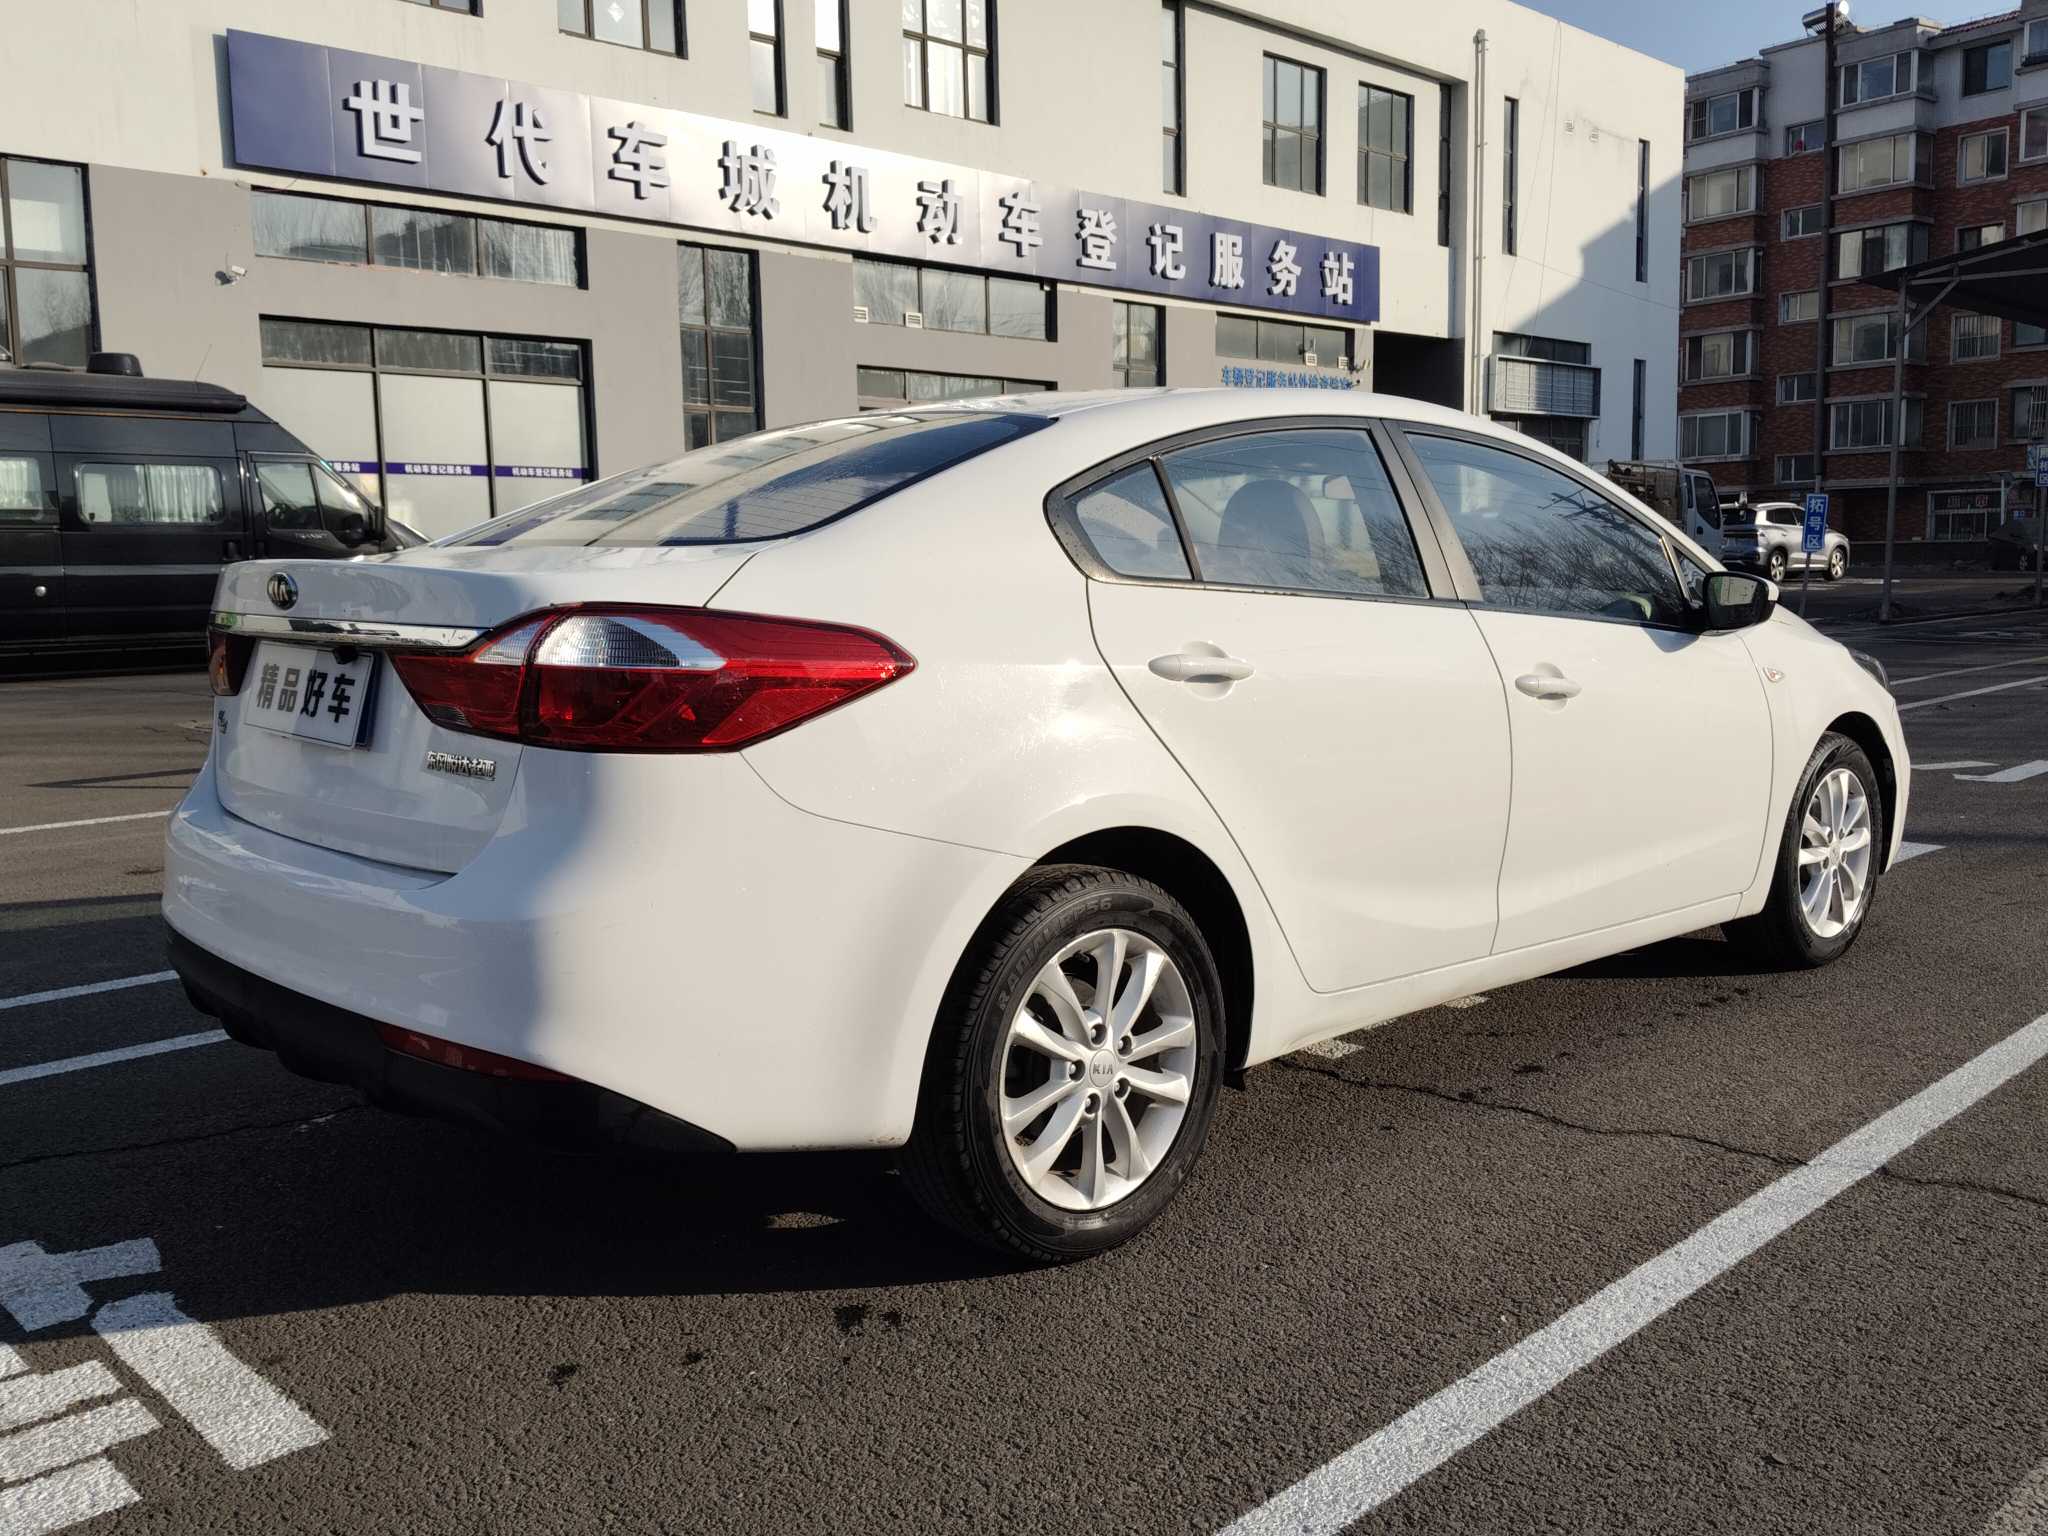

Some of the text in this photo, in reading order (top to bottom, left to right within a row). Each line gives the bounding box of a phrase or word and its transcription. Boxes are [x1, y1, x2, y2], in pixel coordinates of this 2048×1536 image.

[343, 79, 1355, 306] 世代车城机动车登记服务站
[330, 462, 360, 473] 服务站
[256, 663, 355, 723] 精品好车
[426, 750, 495, 778] 东风悦达起亚
[1092, 1063, 1114, 1075] KIA
